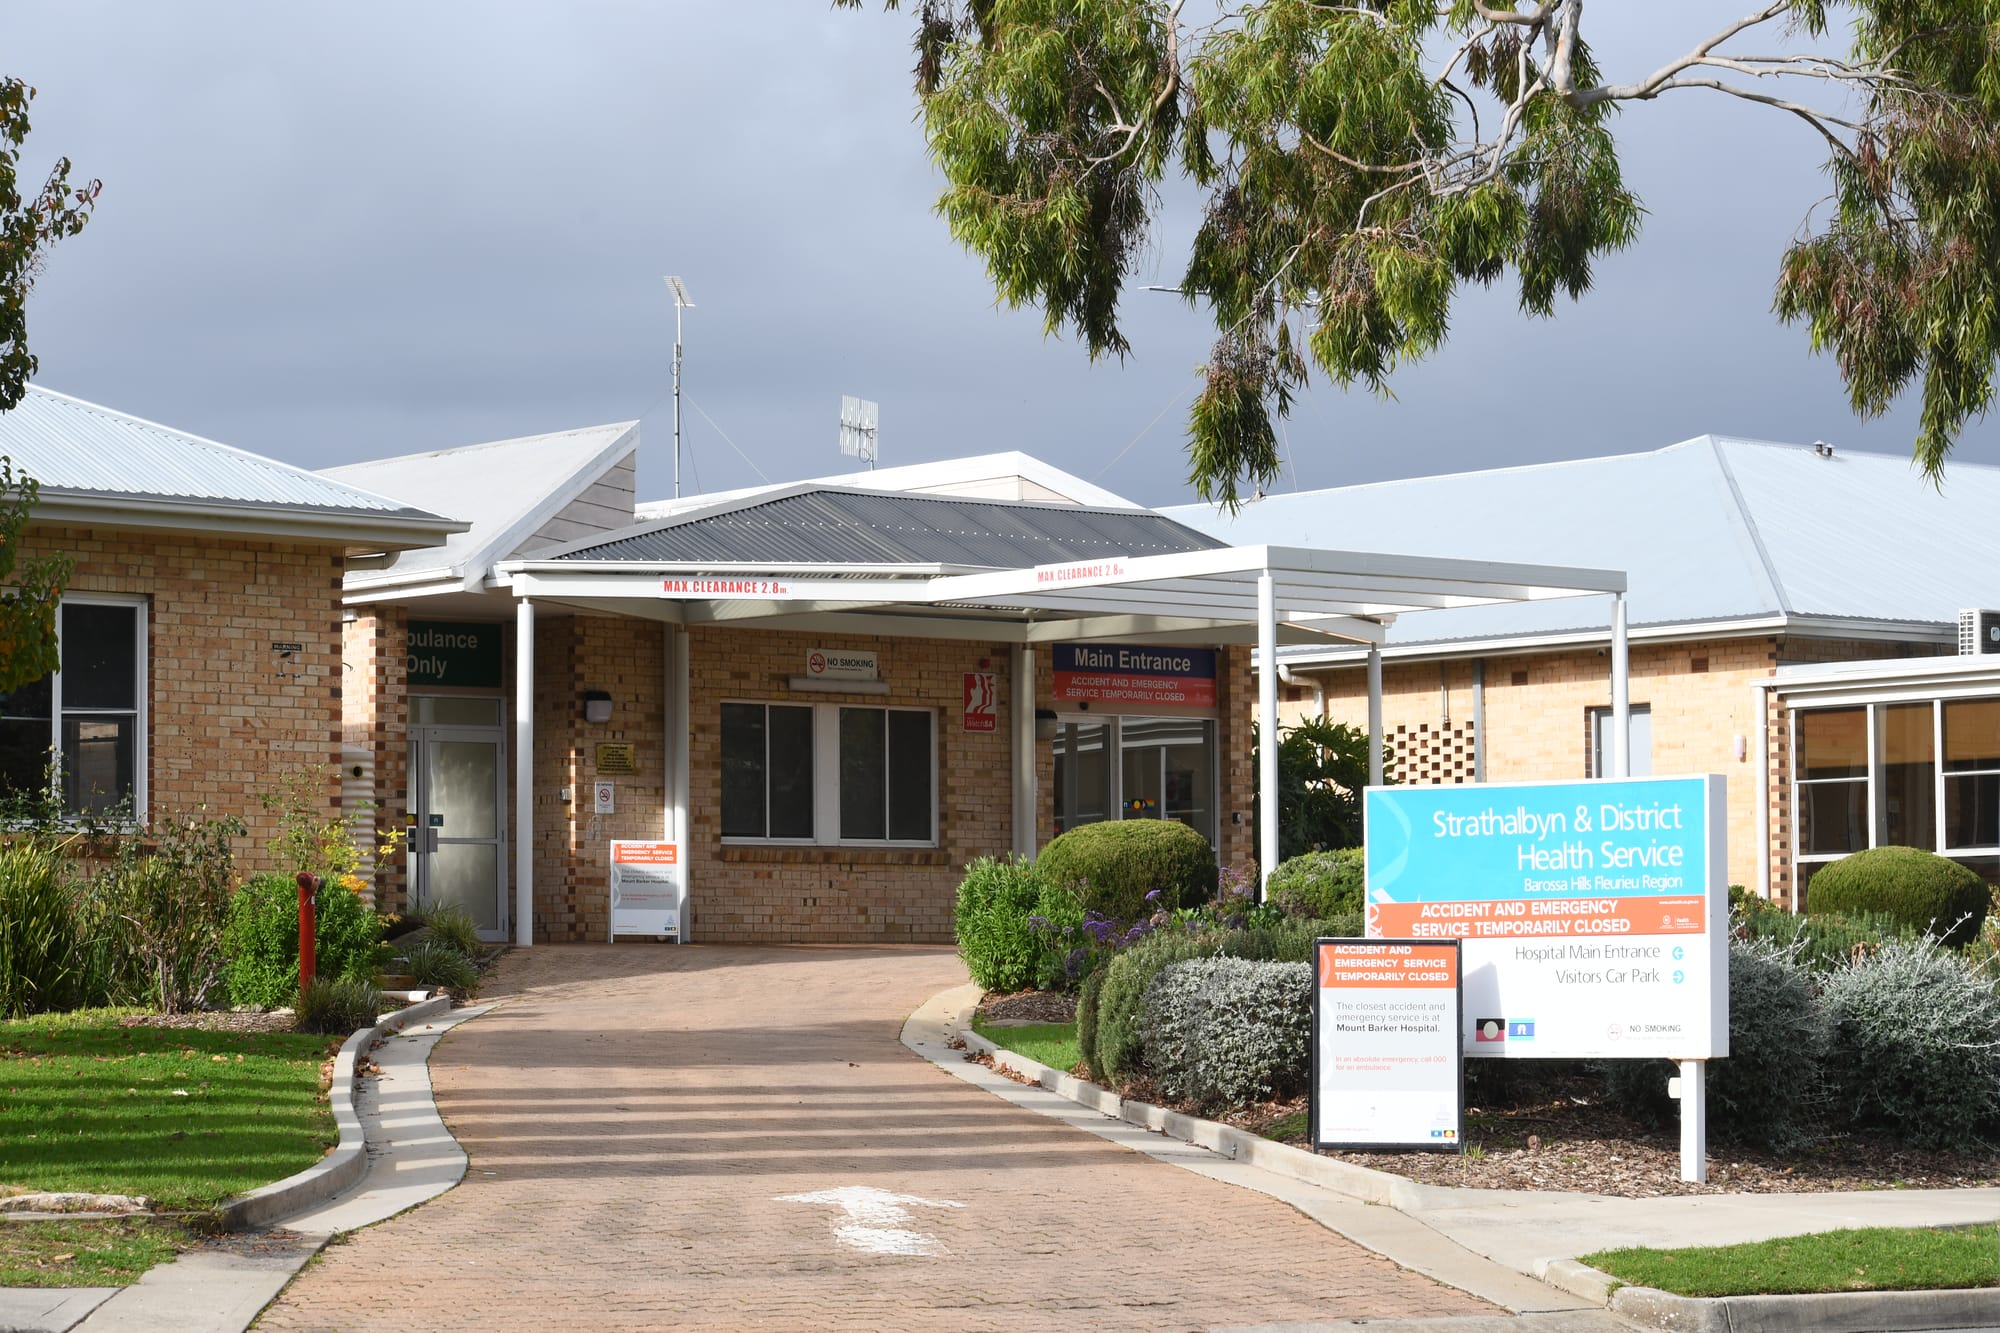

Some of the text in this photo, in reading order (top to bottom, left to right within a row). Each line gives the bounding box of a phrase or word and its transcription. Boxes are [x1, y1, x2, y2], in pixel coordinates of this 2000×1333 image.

[1037, 565, 1103, 583] MAX.CLEARANCE
[663, 580, 758, 593] MAX.CLEARANCE
[407, 628, 478, 648] bulance
[406, 654, 448, 679] Only
[827, 657, 874, 668] NO SMOKING
[1075, 648, 1191, 672] Main Entrance
[1071, 676, 1179, 690] ACCIDENT AND EMERGENCY
[1066, 687, 1099, 698] SERVICE
[1102, 689, 1154, 700] TEMPORARILY
[1155, 692, 1186, 702] CLOSED
[1433, 801, 1683, 841] Strathalbyn & District
[1517, 838, 1684, 871] Health Service
[1524, 874, 1683, 892] Barossa Hills Fleurieu Region
[1421, 900, 1619, 918] ACCIDENT AND EMERGENCY
[1412, 918, 1631, 937] SERVICE TEMPORARILY CLOSED
[1335, 945, 1412, 955] ACCIDENT AND
[1515, 944, 1661, 964] Hospital Main Entrance
[1335, 959, 1447, 968] EMERGENCY SERVICE
[1335, 972, 1449, 981] TEMPORARILY CLOSED
[1555, 967, 1661, 985] Visitors Car Park
[1336, 1002, 1446, 1011] The closest accident and
[1336, 1014, 1441, 1024] emergency service is at
[1336, 1024, 1441, 1034] Mount Barker Hospital.
[1629, 1024, 1682, 1033] NO SMOKING
